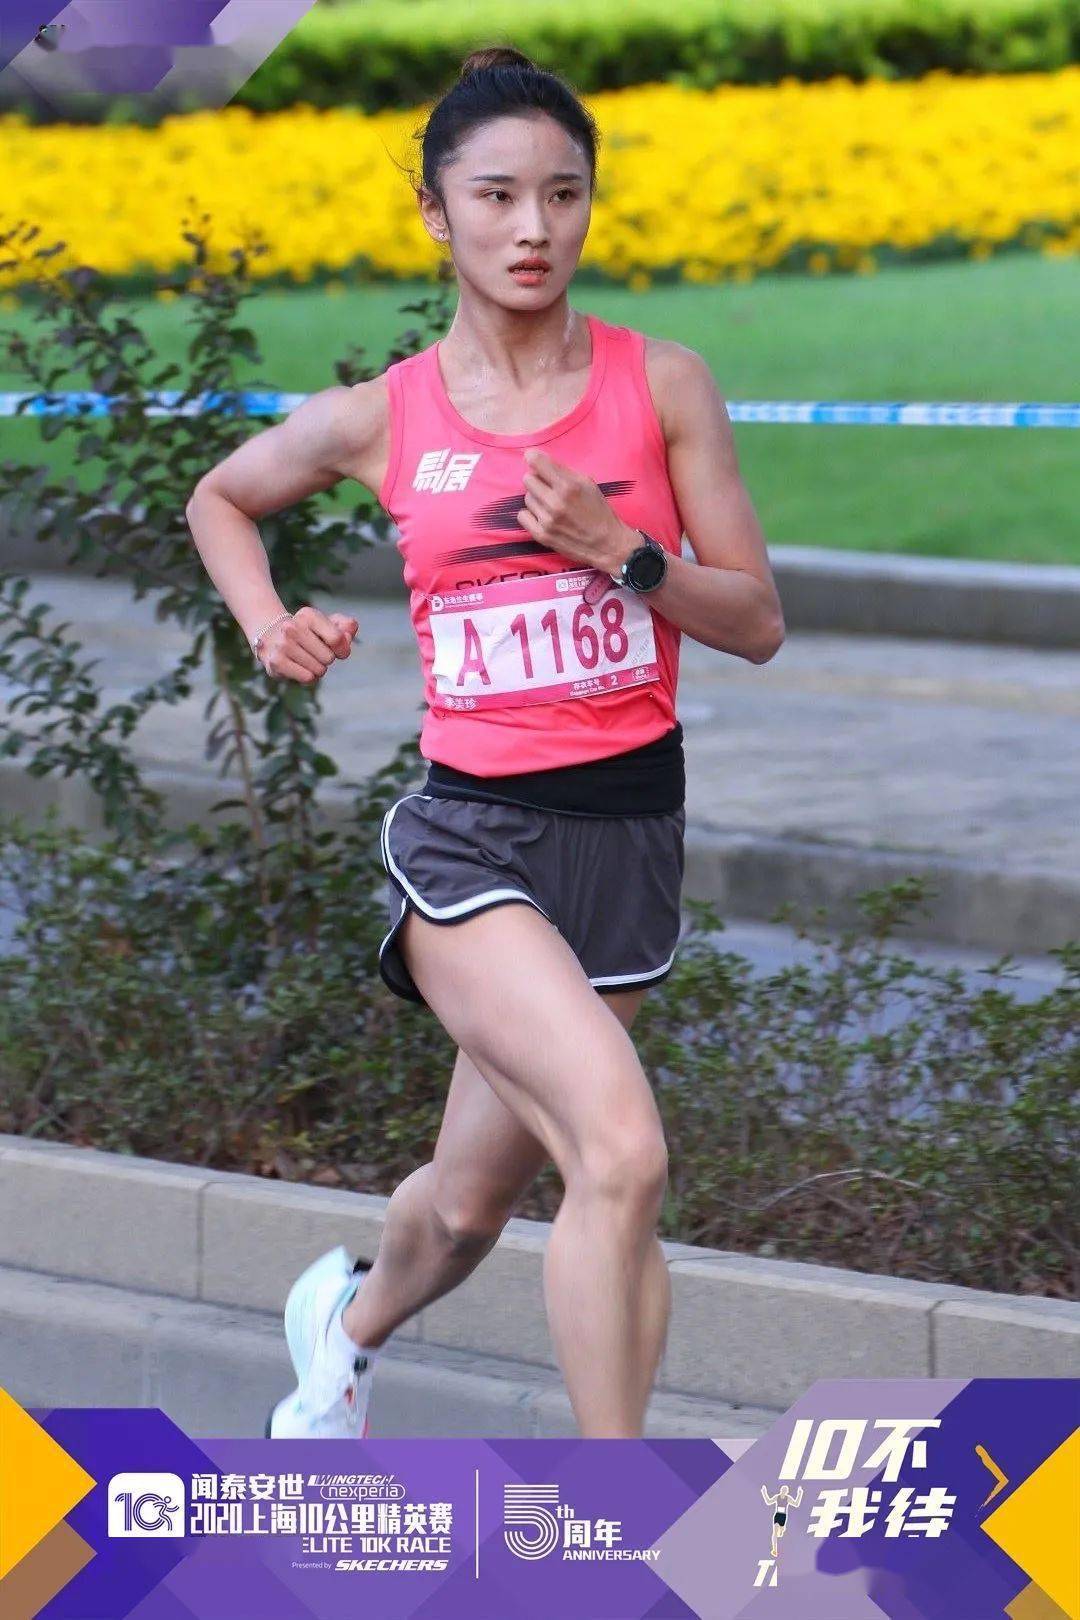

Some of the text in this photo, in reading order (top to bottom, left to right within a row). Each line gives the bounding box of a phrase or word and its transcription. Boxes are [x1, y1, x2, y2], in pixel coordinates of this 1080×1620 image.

[457, 598, 629, 686] A 1168
[610, 675, 618, 686] 2
